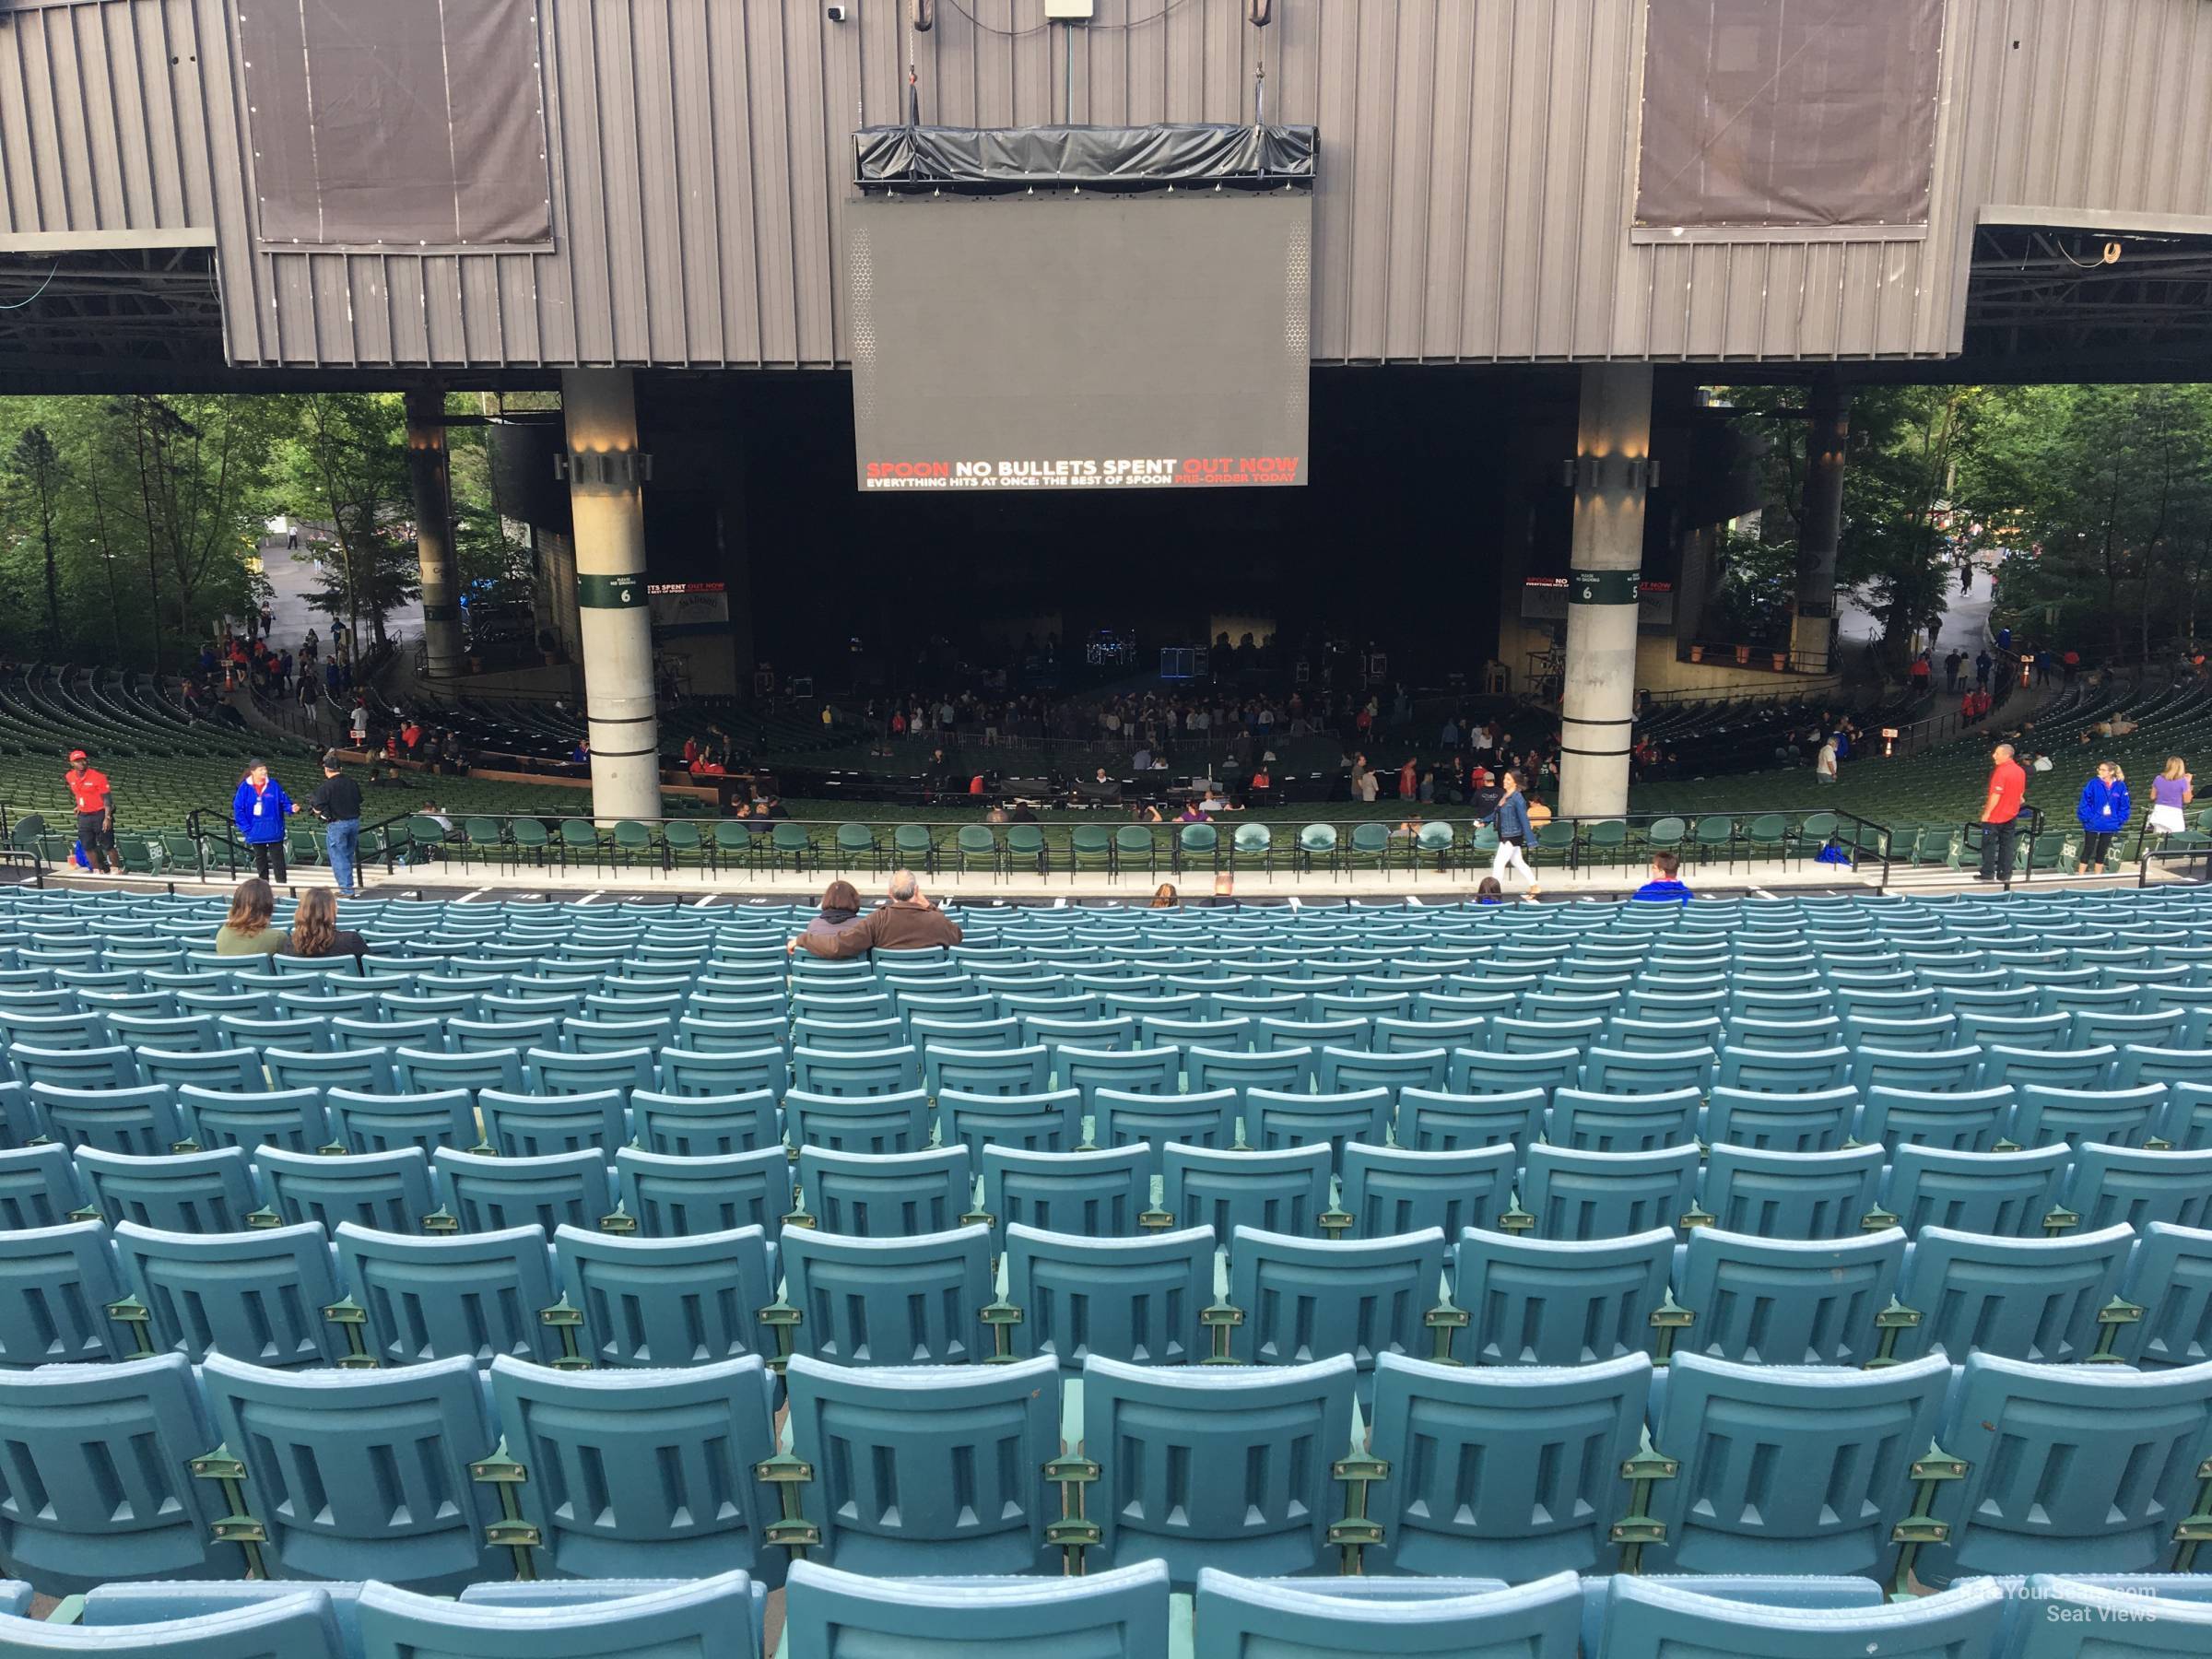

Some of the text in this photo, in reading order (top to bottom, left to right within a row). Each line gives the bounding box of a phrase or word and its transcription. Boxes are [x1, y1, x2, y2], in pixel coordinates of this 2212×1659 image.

[866, 456, 1300, 477] SPOON NO BULLETS SPENT OUT NOW
[866, 473, 1296, 488] EVERYTHING HITS AT ONCE: THE BEST OF SPOON PRE-ORDER TODAY
[620, 589, 631, 603] 6
[1583, 586, 1593, 599] 6
[149, 845, 163, 860] BB
[1952, 843, 1959, 856] Z
[2063, 842, 2077, 858] BB
[2107, 847, 2121, 862] CC
